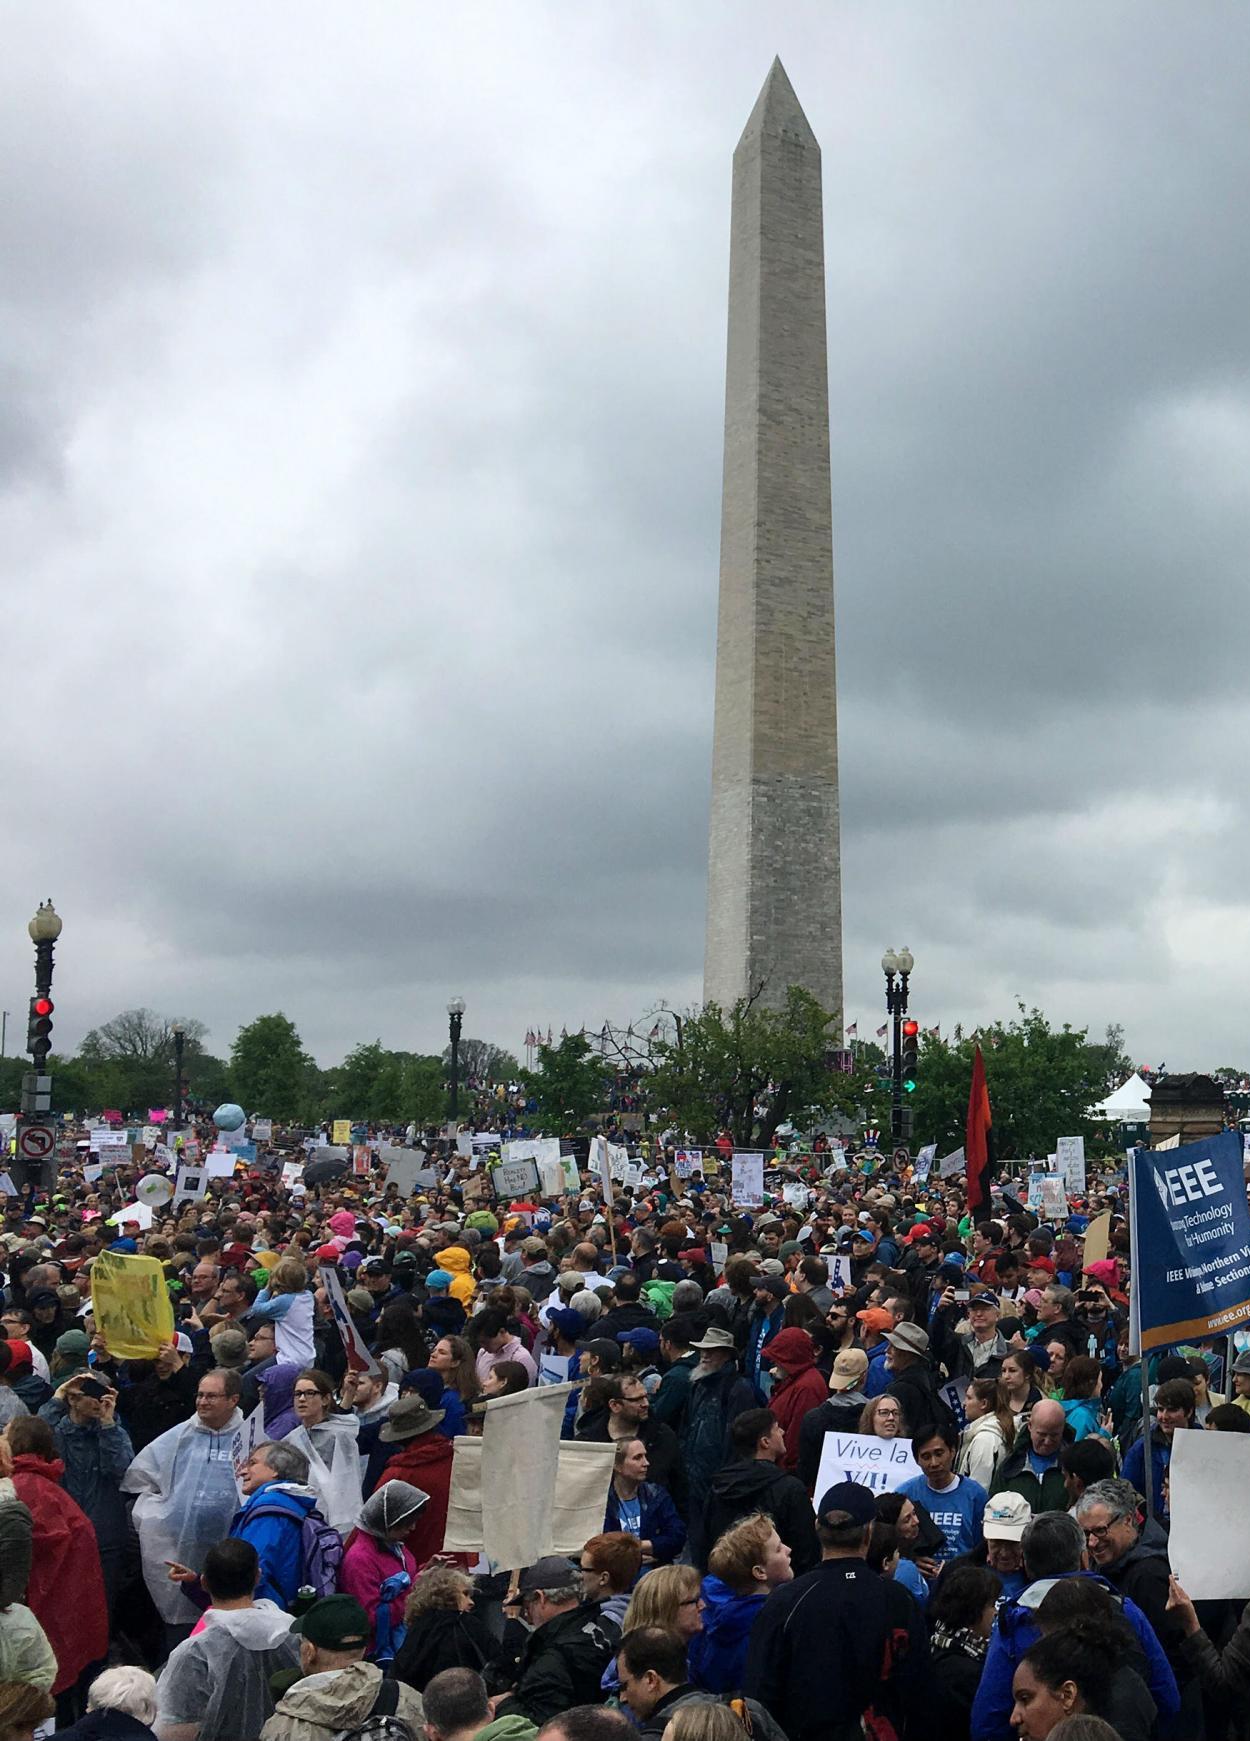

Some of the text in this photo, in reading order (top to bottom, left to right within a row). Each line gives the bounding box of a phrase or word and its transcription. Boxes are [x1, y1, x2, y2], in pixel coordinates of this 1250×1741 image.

[1184, 1203, 1233, 1229] Technology
[1192, 1222, 1234, 1245] Humanity
[1166, 1269, 1185, 1283] IEEE
[1201, 1252, 1240, 1275] Northern
[837, 1439, 908, 1464] Vive la
